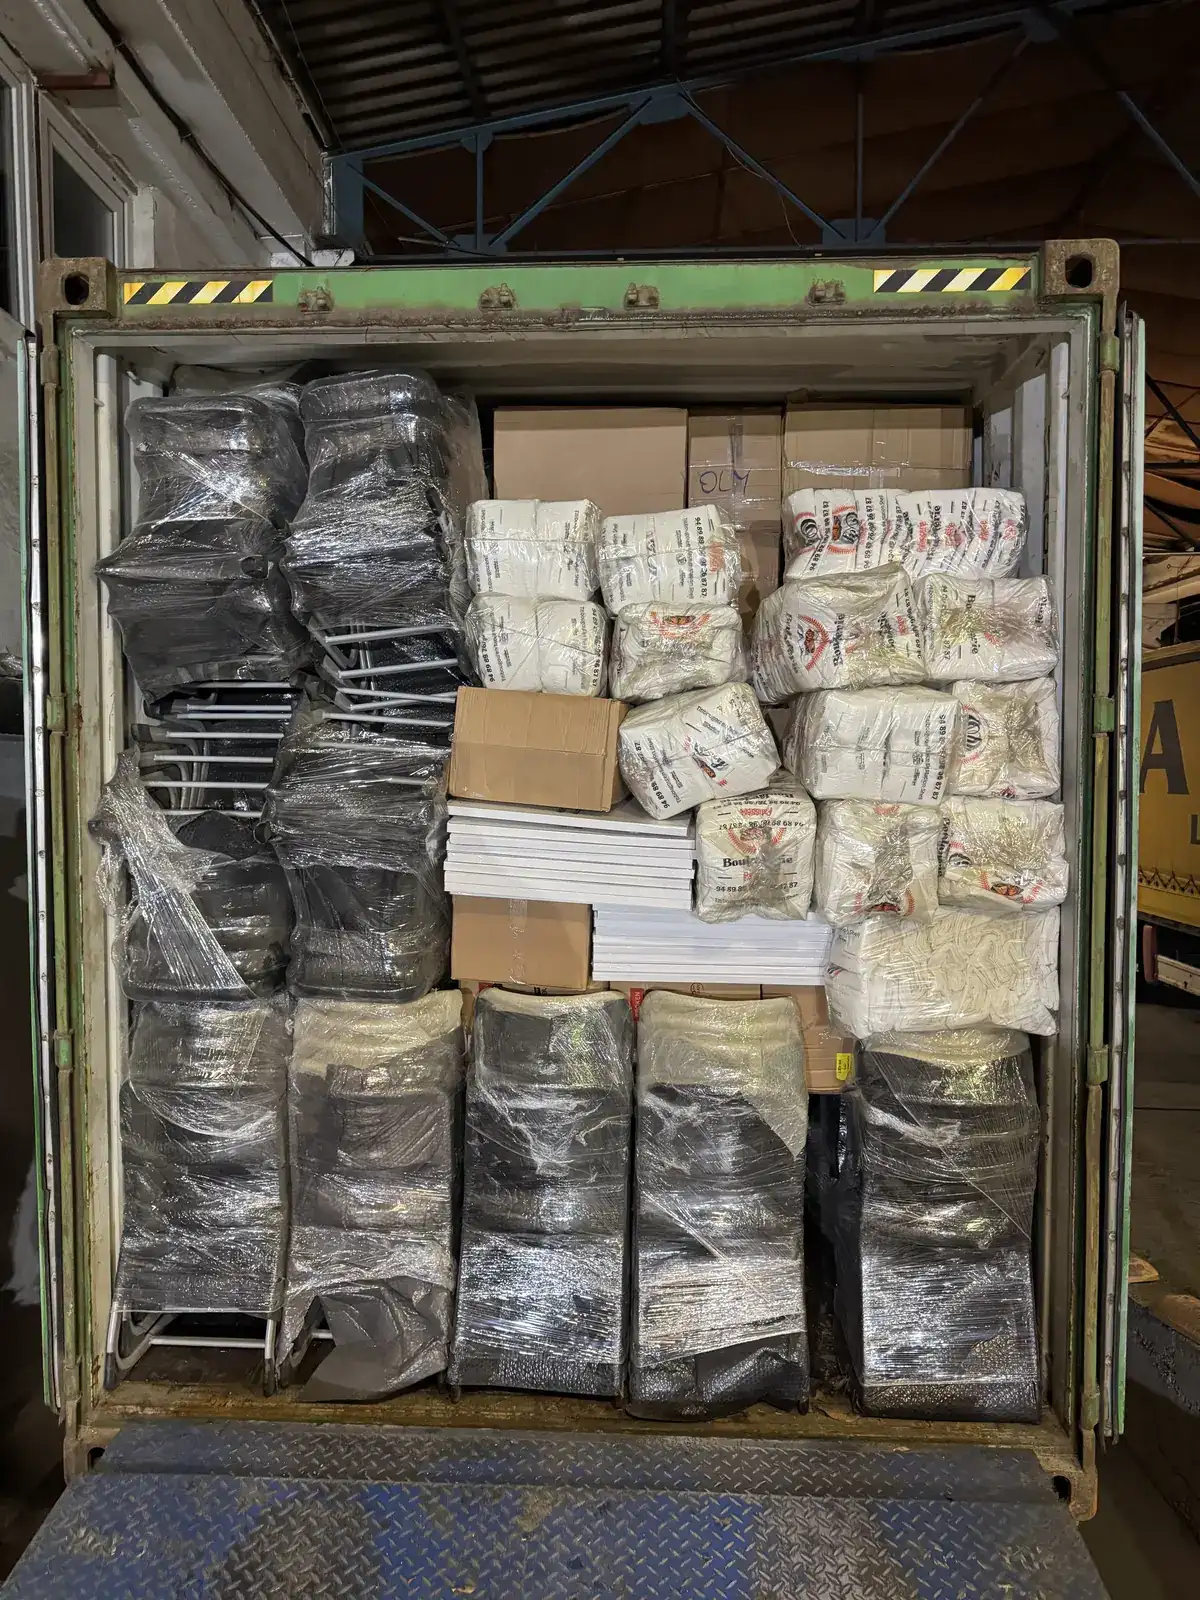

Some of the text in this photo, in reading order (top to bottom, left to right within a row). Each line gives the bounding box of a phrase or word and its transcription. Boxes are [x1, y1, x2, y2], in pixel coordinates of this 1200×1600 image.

[866, 505, 874, 513] 87
[694, 516, 702, 525] 94
[696, 526, 704, 535] 89
[701, 577, 708, 587] 87
[701, 587, 708, 597] 87
[482, 654, 490, 663] 89
[485, 664, 493, 673] 89
[593, 668, 601, 677] 87
[488, 673, 496, 683] 94
[939, 725, 947, 735] 89
[634, 742, 642, 751] 87
[1140, 699, 1190, 794] A
[651, 781, 659, 791] 89
[934, 781, 942, 790] 87
[655, 791, 665, 800] 89
[931, 791, 940, 800] 87
[661, 800, 670, 809] 94
